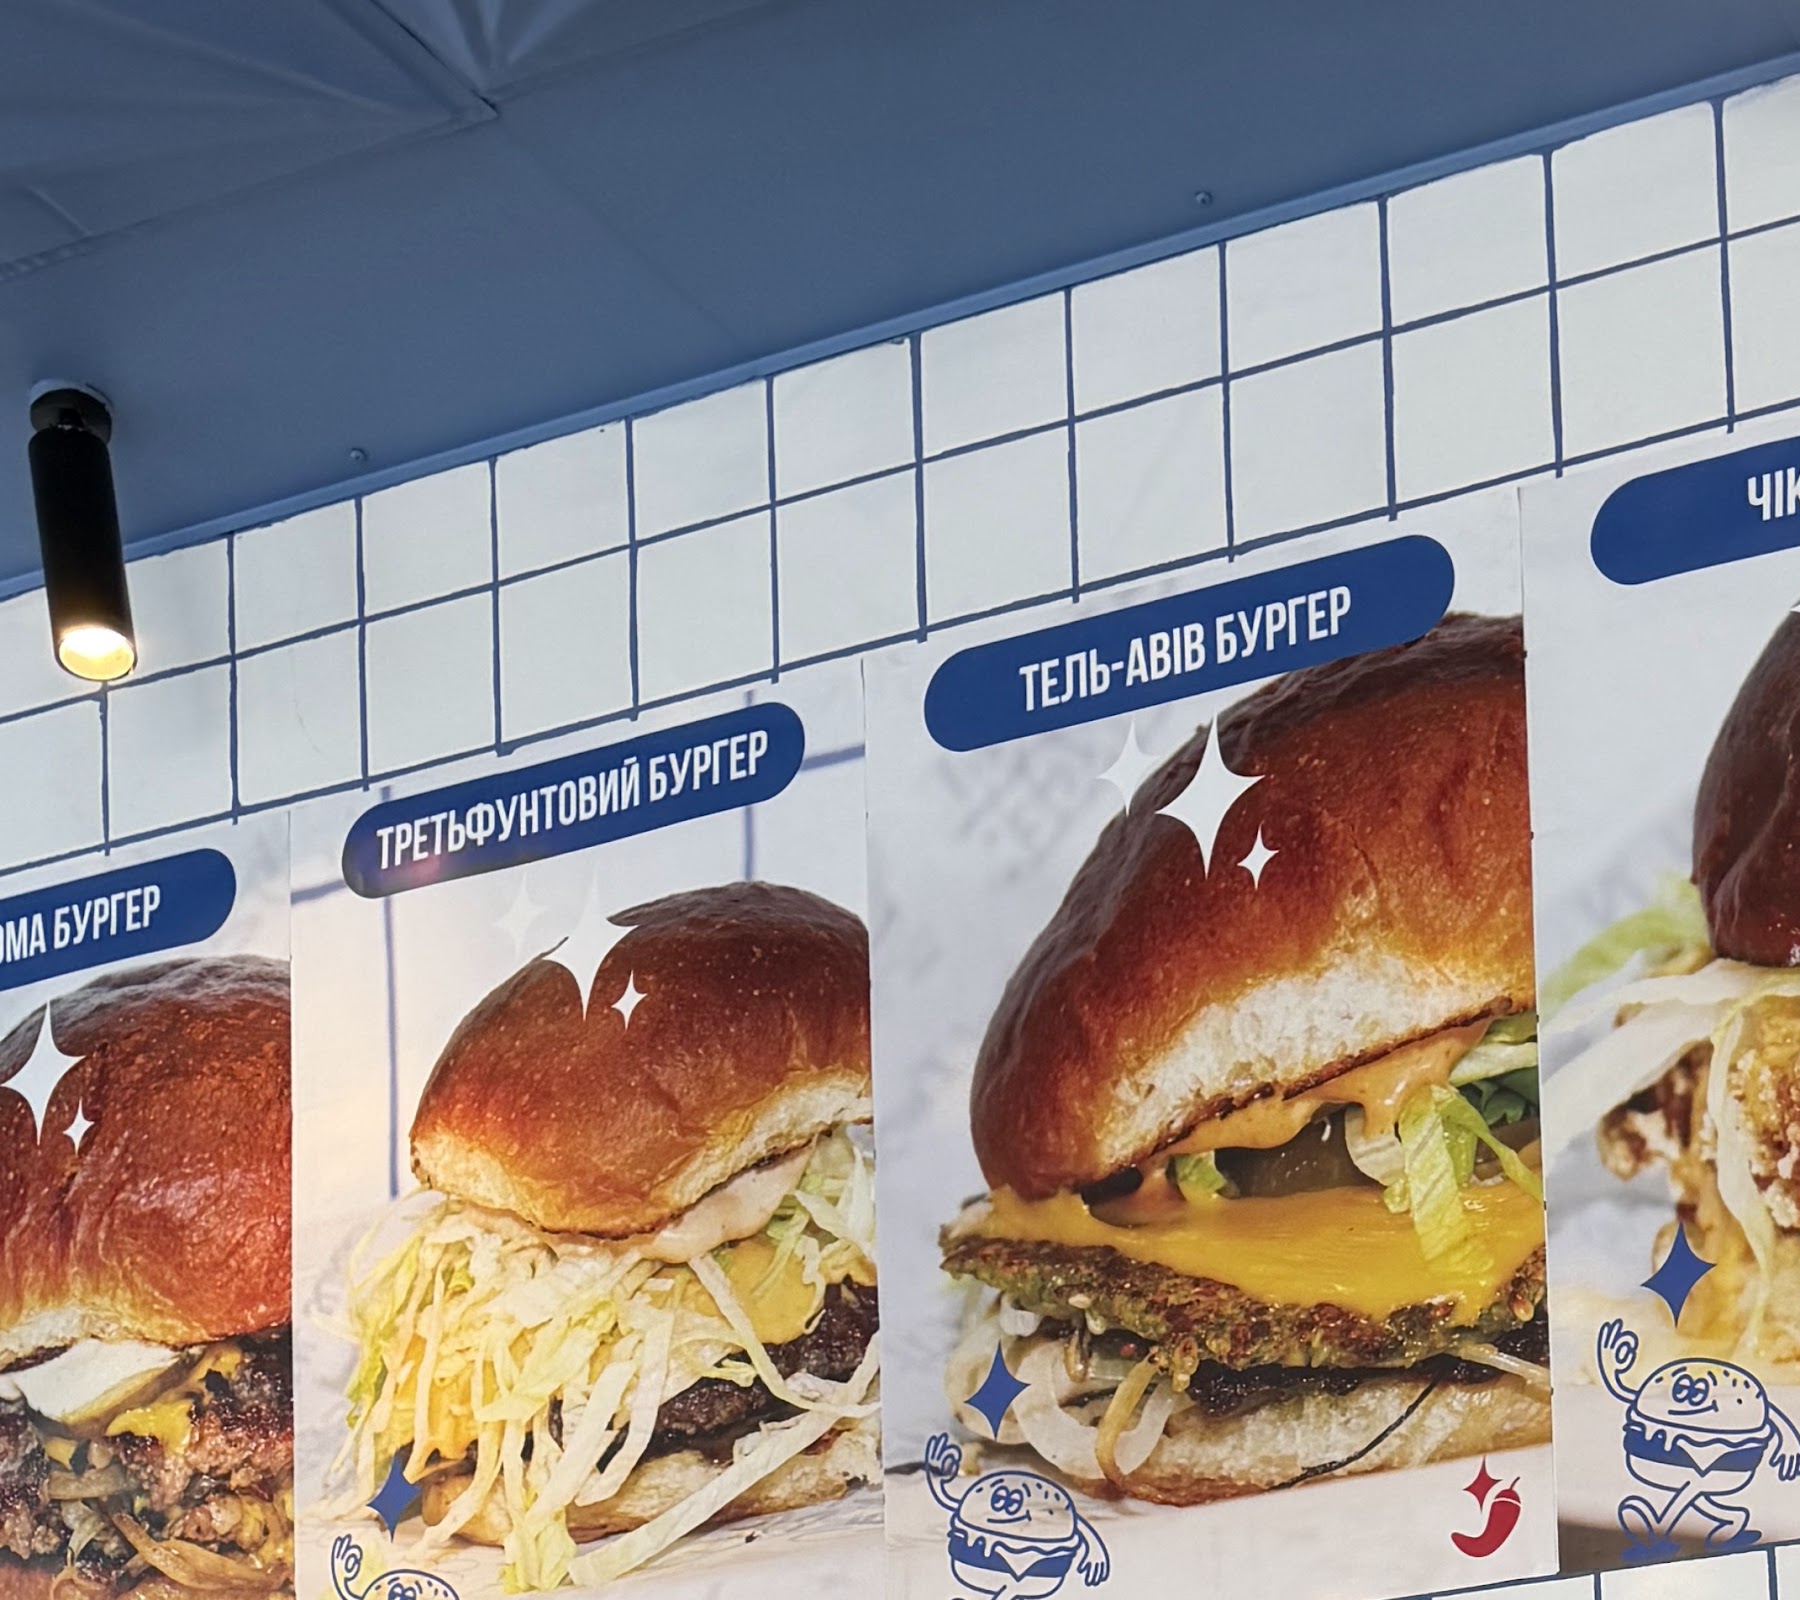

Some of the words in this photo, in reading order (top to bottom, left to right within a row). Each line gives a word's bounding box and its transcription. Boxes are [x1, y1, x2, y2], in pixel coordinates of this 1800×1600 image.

[1019, 623, 1205, 711] ТЕЛЬ-АВІВ
[1216, 587, 1350, 663] БУРГЕР
[377, 757, 639, 869] ТРЕТЬФУНТОВИЙ
[650, 731, 767, 801] БУРГЕР
[54, 885, 160, 948] БУРГЕР
